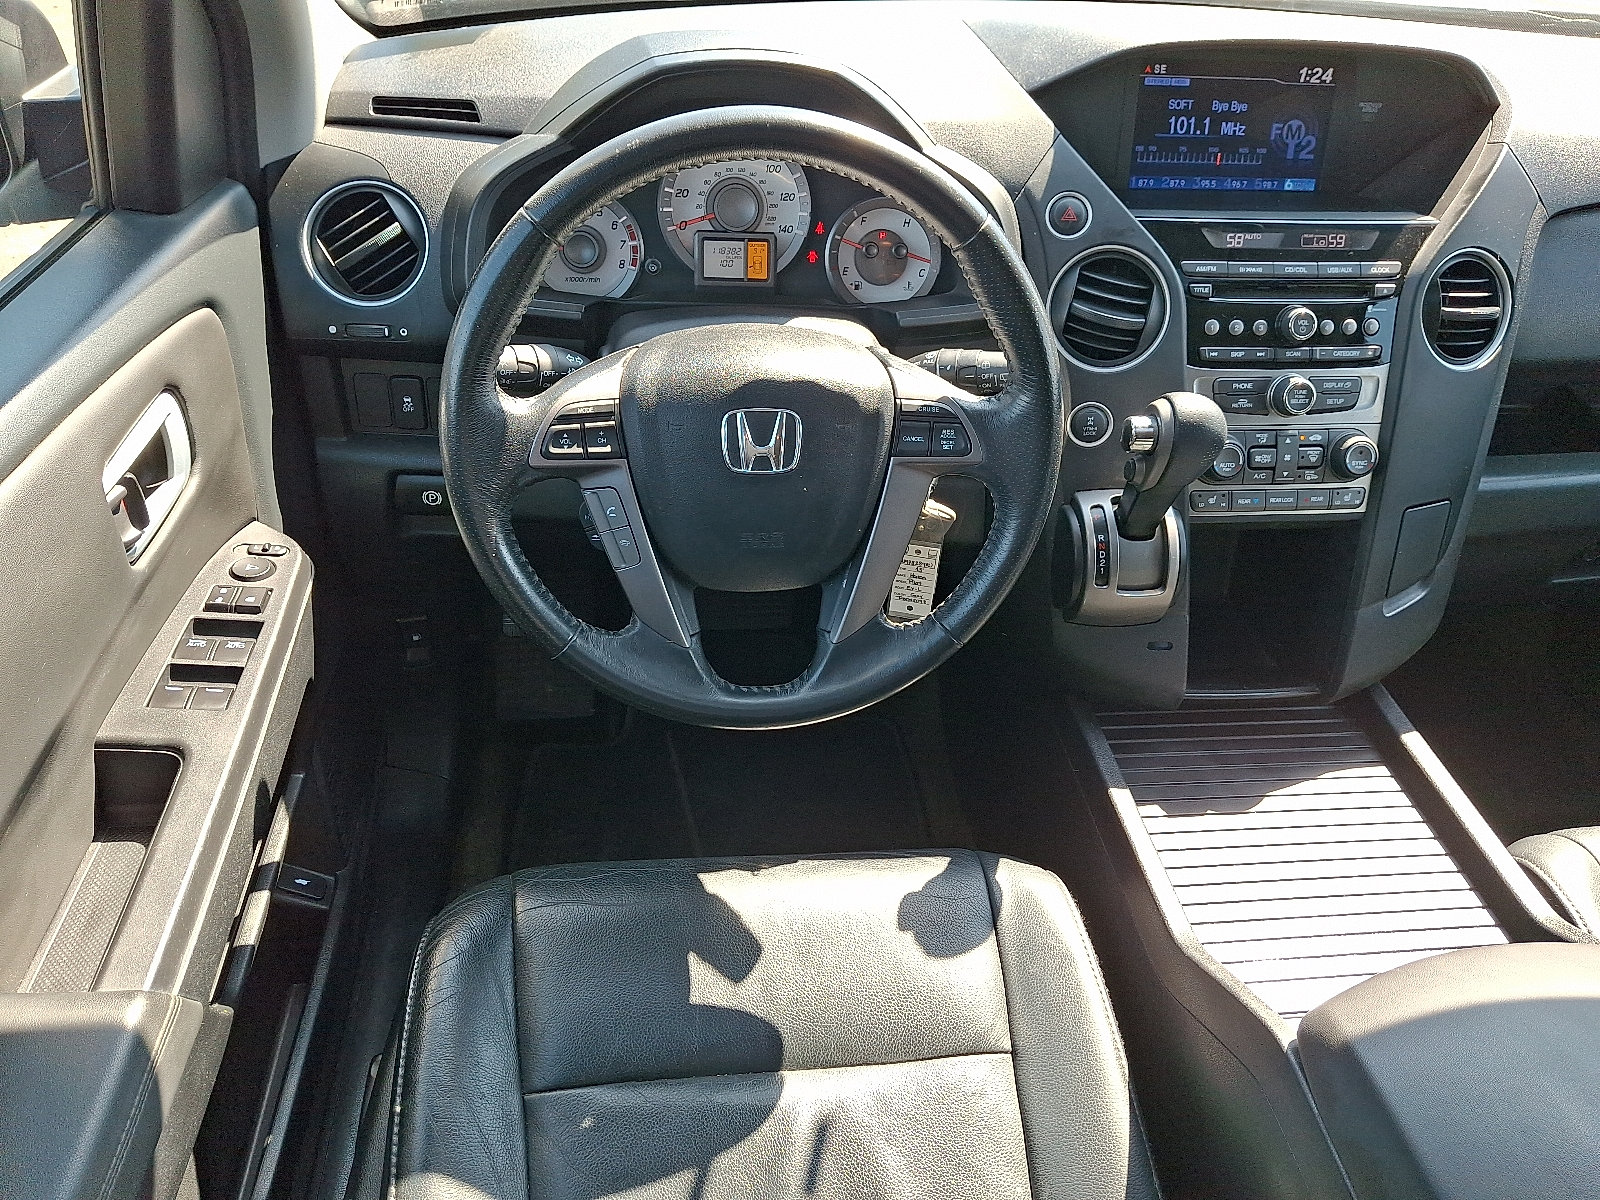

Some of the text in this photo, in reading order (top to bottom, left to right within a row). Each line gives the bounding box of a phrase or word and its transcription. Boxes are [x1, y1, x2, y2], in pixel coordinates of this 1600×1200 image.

[1153, 64, 1168, 74] SE
[1299, 67, 1334, 84] 1:24
[1168, 99, 1248, 113] SOFT Bye Bye
[1168, 115, 1246, 136] 101.1 MHz
[766, 164, 781, 173] 100
[675, 189, 689, 198] 20
[780, 192, 795, 201] 120
[611, 221, 618, 230] 6
[679, 221, 687, 230] 0
[860, 217, 867, 225] F
[902, 219, 911, 228] H
[778, 225, 793, 233] 140
[620, 240, 626, 250] 7
[712, 247, 742, 255] 118382
[619, 260, 625, 269] 8
[842, 267, 849, 276] E
[918, 269, 925, 277] C
[1100, 559, 1105, 567] 2
